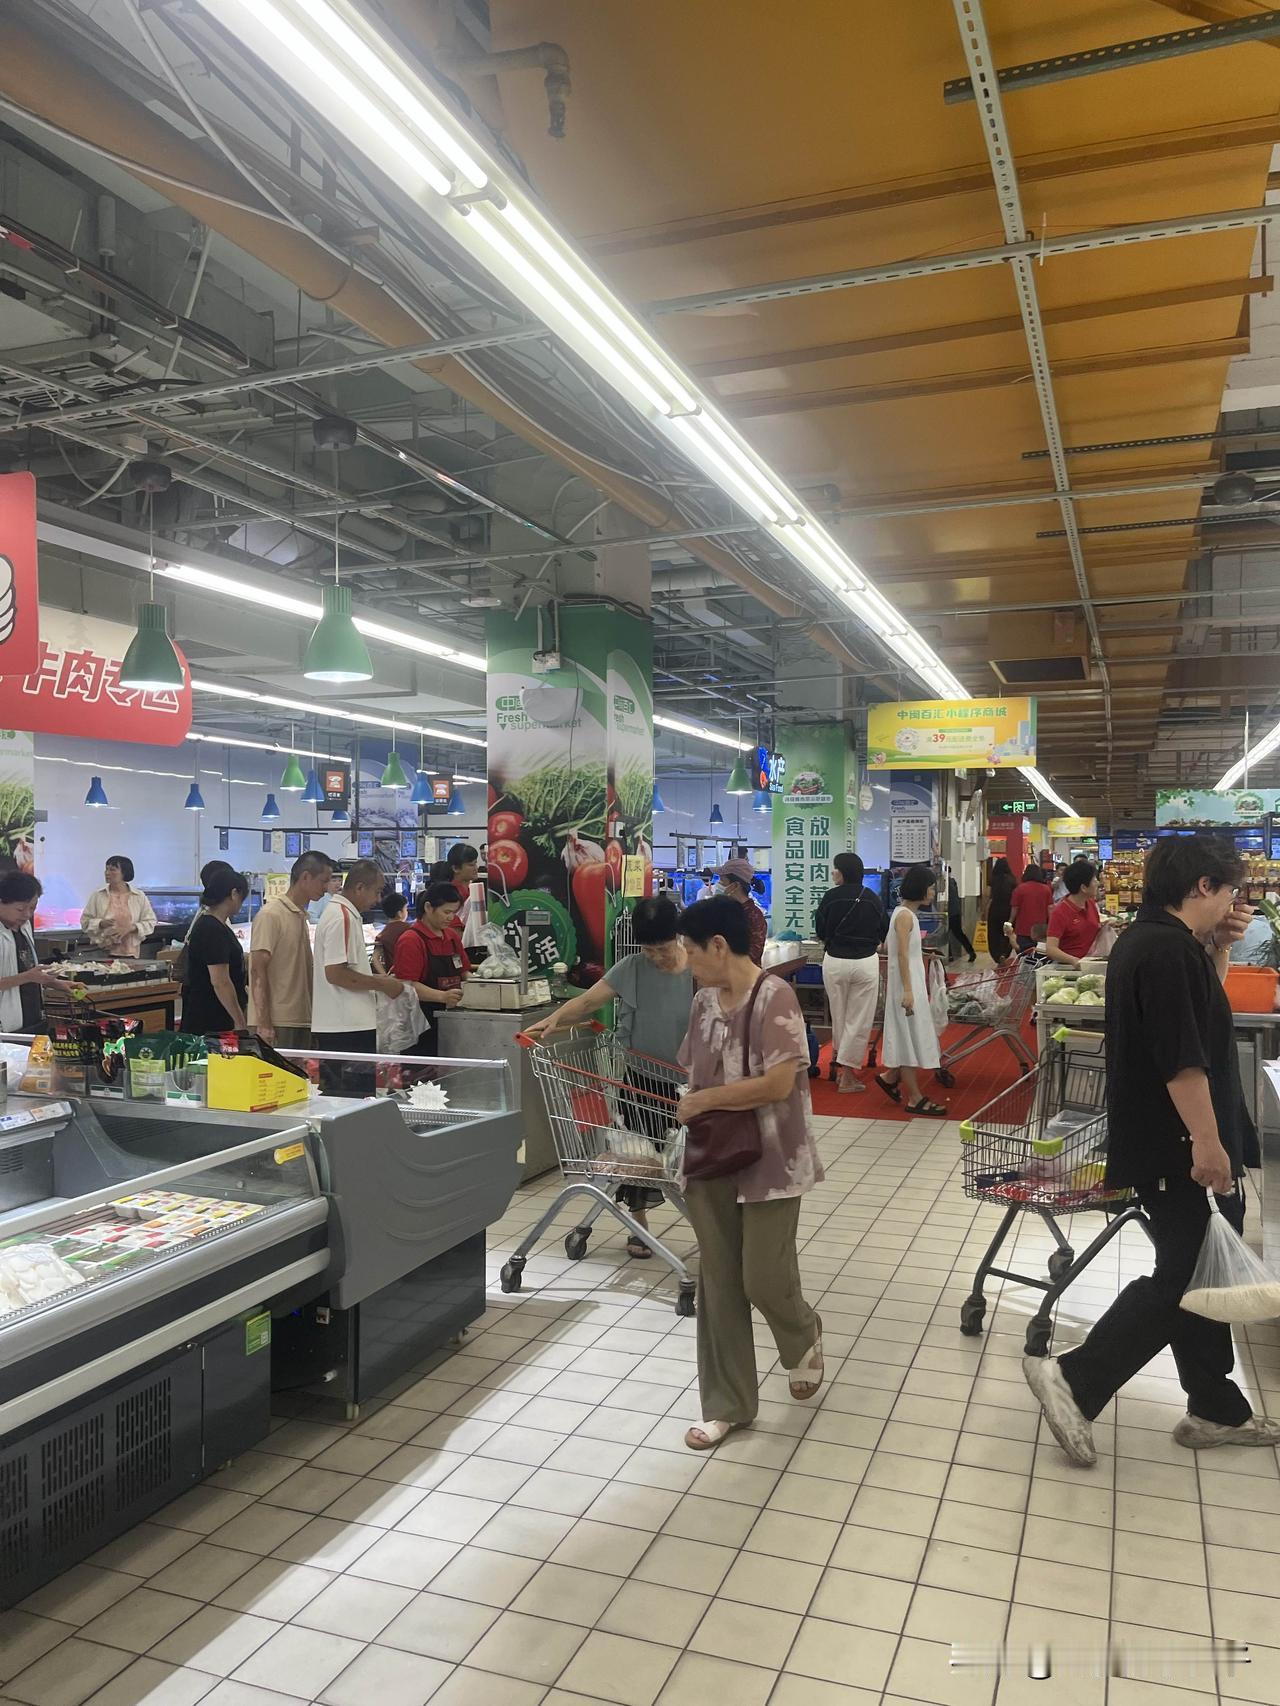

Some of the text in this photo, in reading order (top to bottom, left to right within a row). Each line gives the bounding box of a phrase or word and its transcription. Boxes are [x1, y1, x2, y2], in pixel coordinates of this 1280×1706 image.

[496, 712, 528, 724] Fresh
[897, 707, 1007, 720] 中闽百汇 小程序商城
[510, 718, 582, 732] superket
[769, 754, 785, 783] 水产
[785, 816, 805, 940] 食品安全无
[810, 816, 830, 940] 放心肉菜
